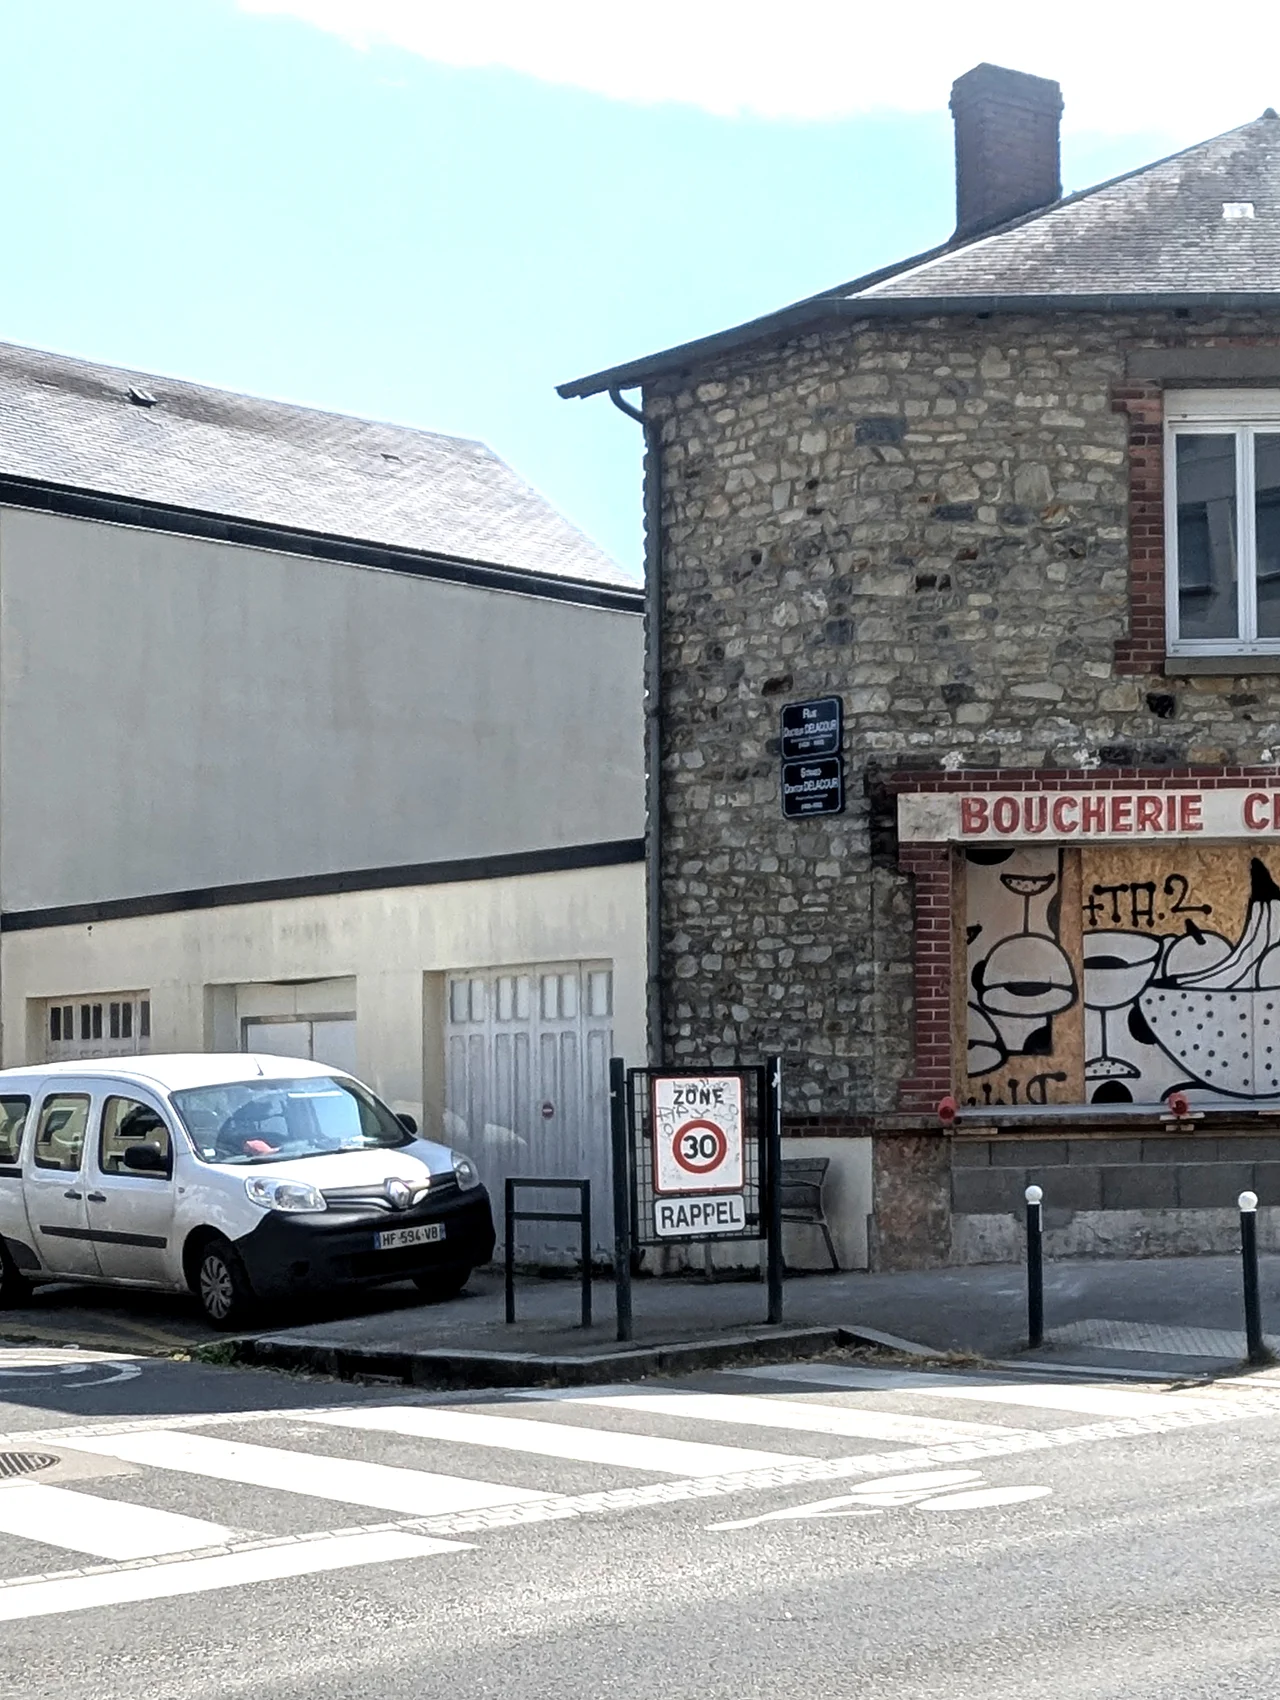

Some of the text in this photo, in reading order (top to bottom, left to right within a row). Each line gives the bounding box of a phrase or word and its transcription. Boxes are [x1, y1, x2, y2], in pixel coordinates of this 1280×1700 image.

[961, 794, 1203, 835] BOUCHERIE
[673, 1088, 724, 1105] ZONE
[683, 1134, 718, 1160] 30
[661, 1201, 741, 1229] RAPPEL
